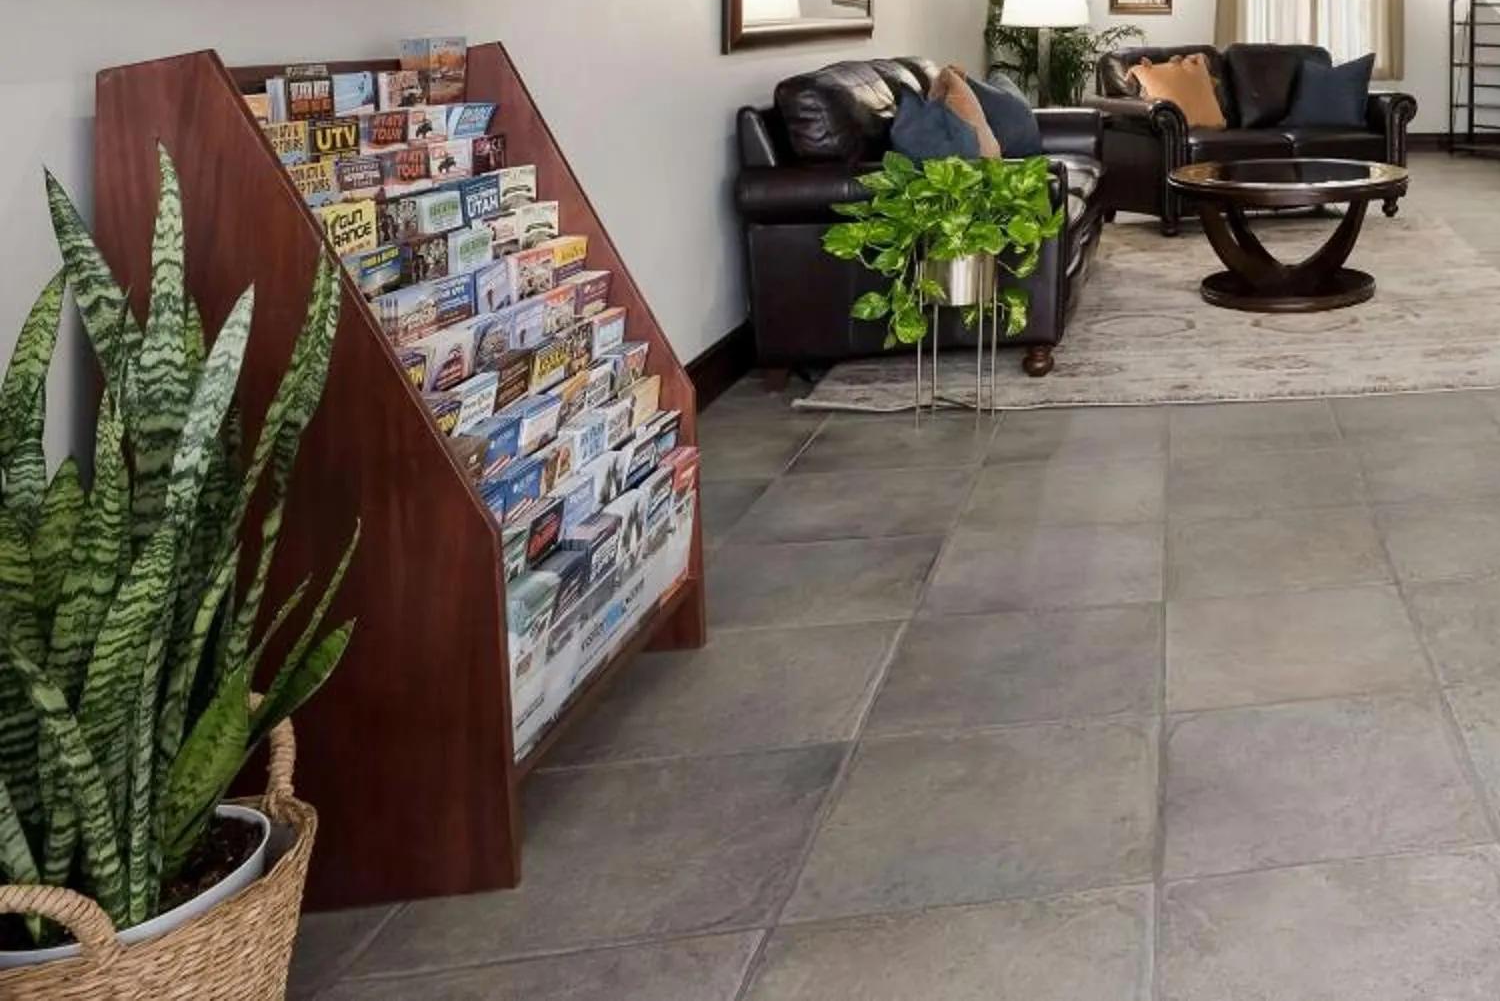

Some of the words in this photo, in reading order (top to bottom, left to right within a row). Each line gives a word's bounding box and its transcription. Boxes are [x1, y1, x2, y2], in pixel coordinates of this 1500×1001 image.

[316, 125, 357, 151] UTV
[339, 208, 363, 230] GUN
[466, 194, 499, 219] UTAH
[333, 220, 372, 247] RANGE
